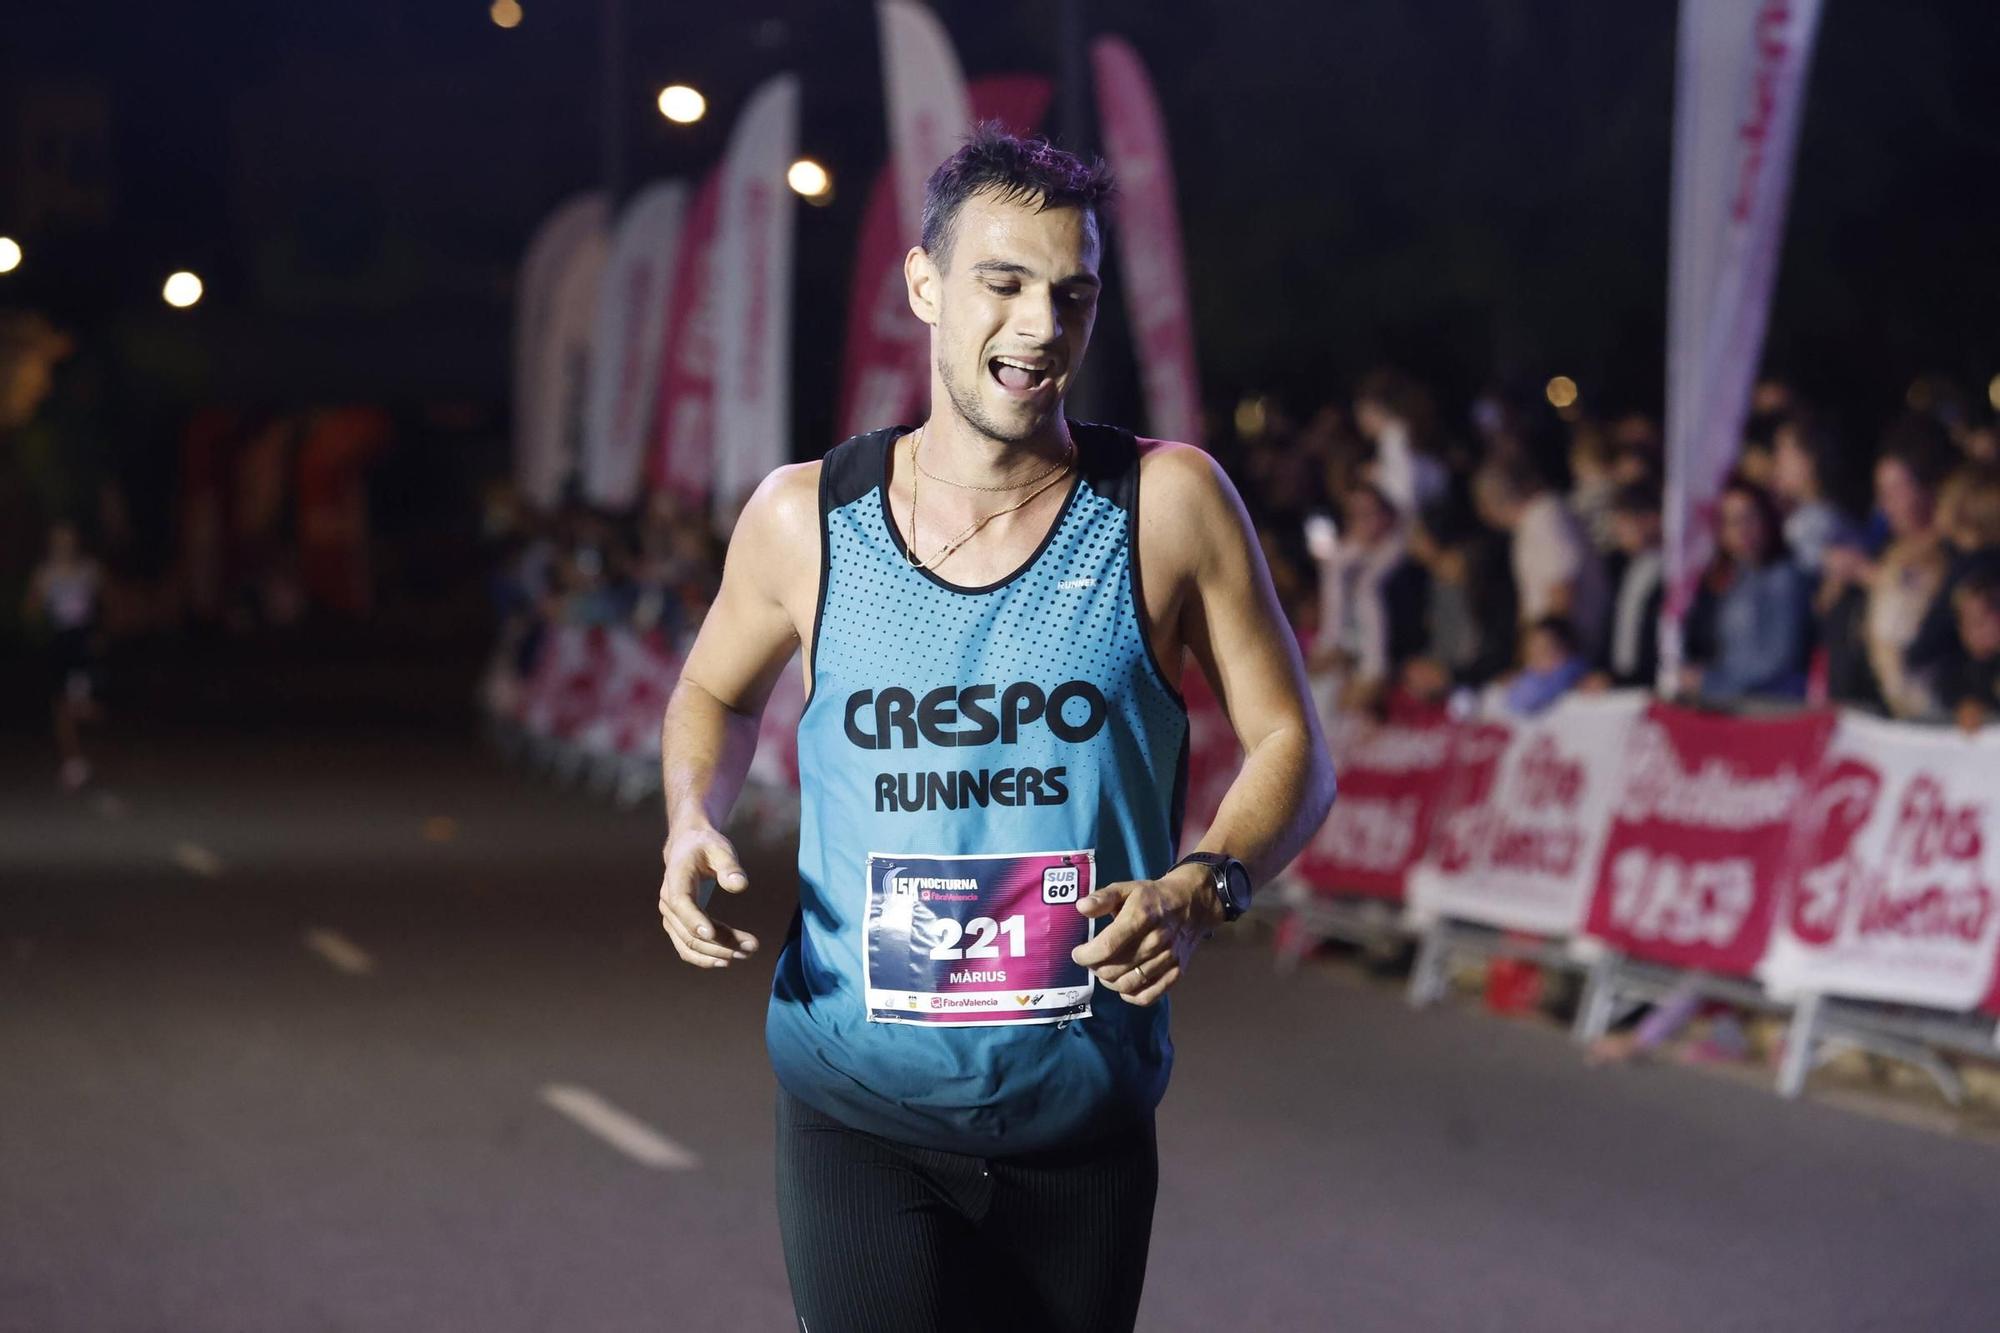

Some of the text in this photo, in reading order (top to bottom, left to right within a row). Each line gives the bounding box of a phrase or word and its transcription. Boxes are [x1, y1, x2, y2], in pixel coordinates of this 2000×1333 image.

[844, 680, 1106, 750] CRESPO
[875, 766, 1069, 812] RUNNERS
[920, 878, 978, 890] NOCTURNA
[1047, 871, 1075, 882] SUB
[929, 914, 1026, 961] 221
[949, 968, 1007, 984] MÀRIUS
[943, 997, 998, 1008] FibraValencia
